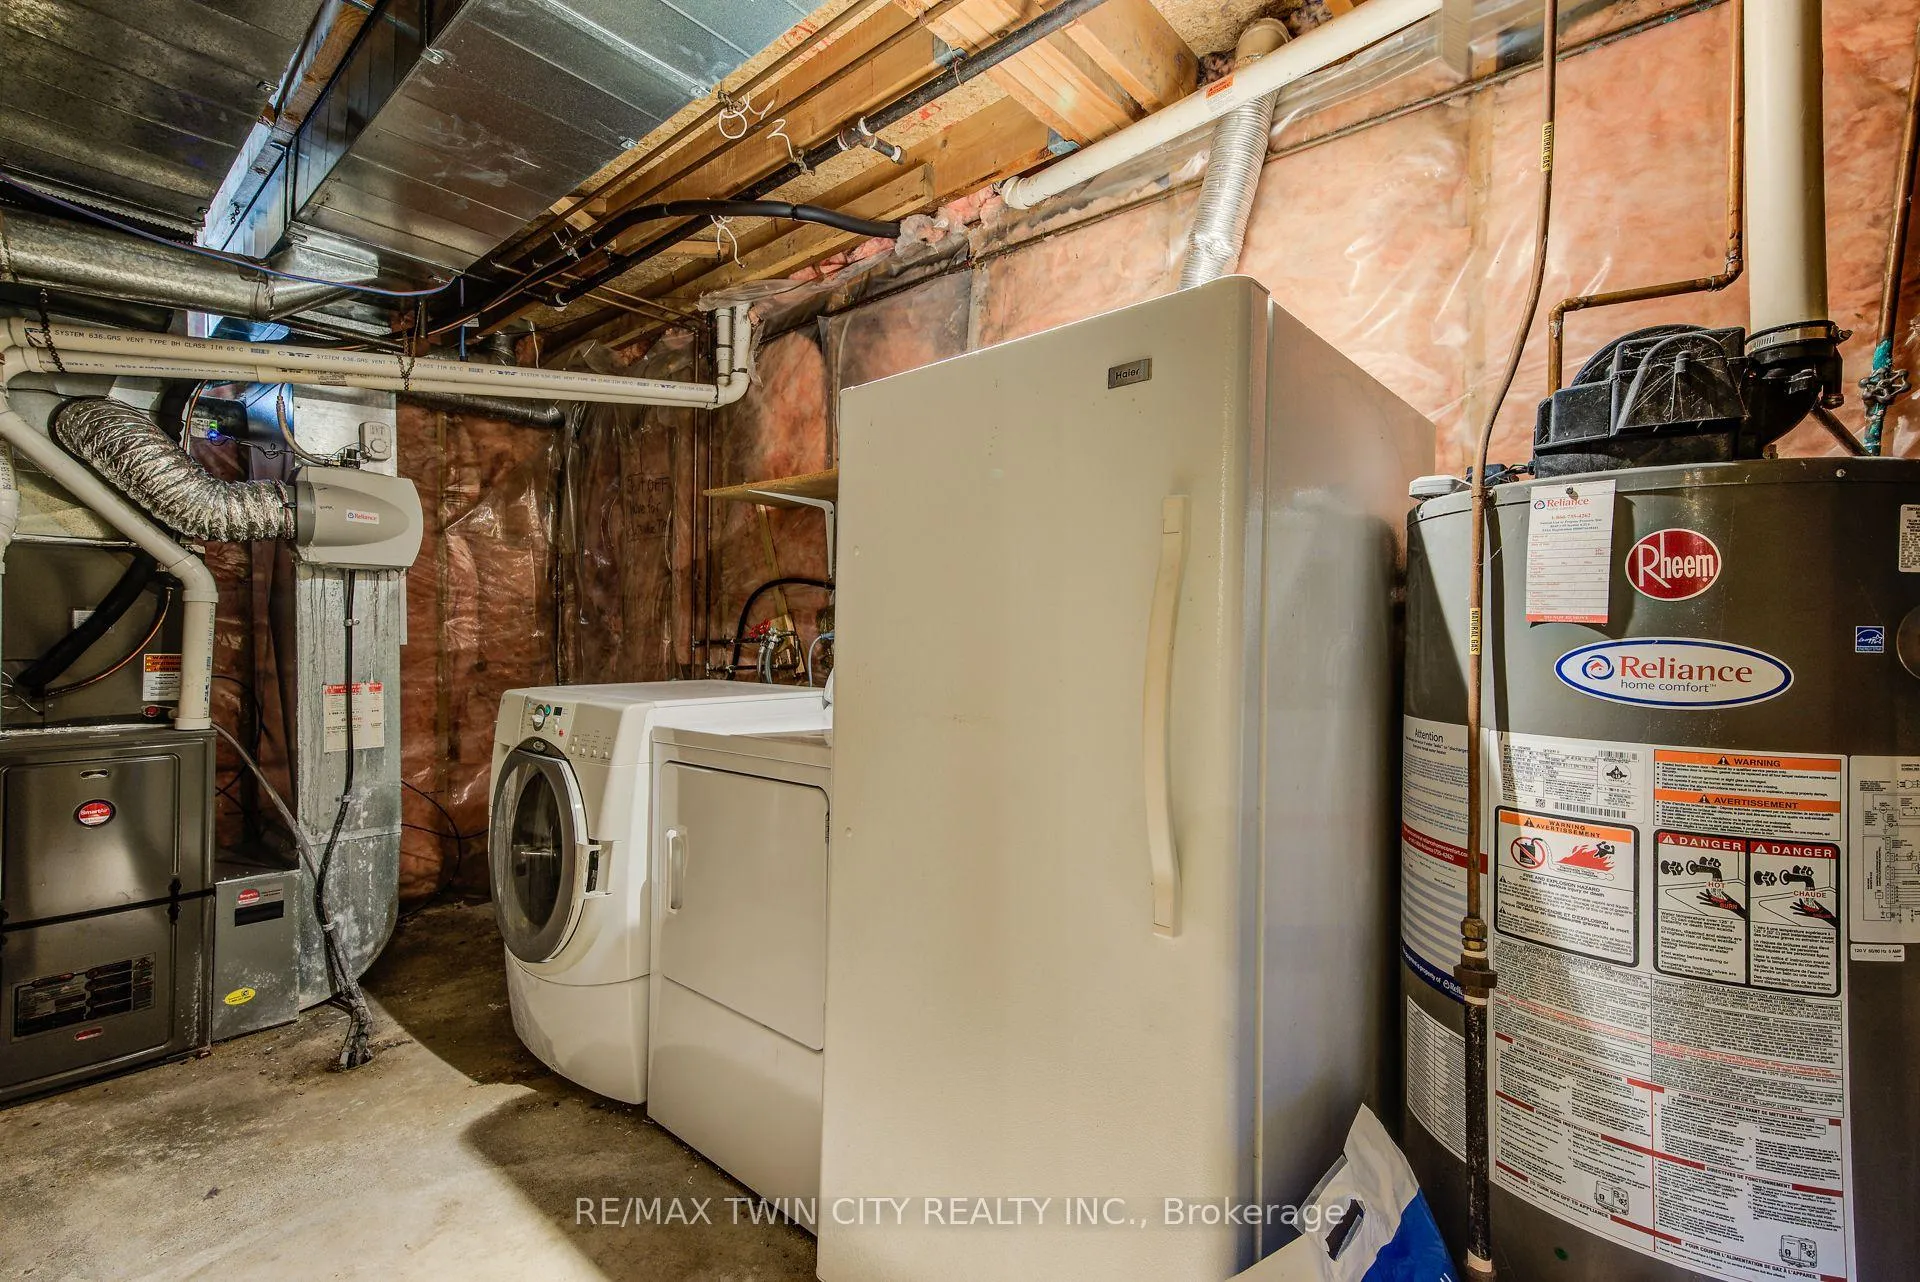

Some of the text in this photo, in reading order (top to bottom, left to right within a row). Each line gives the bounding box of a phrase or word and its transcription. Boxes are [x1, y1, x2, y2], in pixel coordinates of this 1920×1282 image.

[1543, 125, 1552, 169] NATURAL GAS
[54, 330, 84, 338] SYSTEM
[1115, 368, 1140, 380] Haier
[1547, 498, 1589, 508] Reliance
[1637, 531, 1715, 589] Rheem
[1471, 610, 1479, 652] NATURAL GAS
[1618, 655, 1753, 683] Reliance
[1620, 678, 1655, 690] home
[1414, 728, 1444, 744] Attention
[1734, 758, 1781, 768] WARNING
[1714, 798, 1798, 809] AVERTISSEMENT
[1535, 824, 1600, 838] AVERTISSEMENT
[1549, 821, 1585, 831] WARNING
[1680, 837, 1741, 850] DANGER
[1772, 846, 1832, 857] DANGER
[1593, 1068, 1623, 1081] OPERATING
[1580, 1203, 1609, 1218] APPLIANCE
